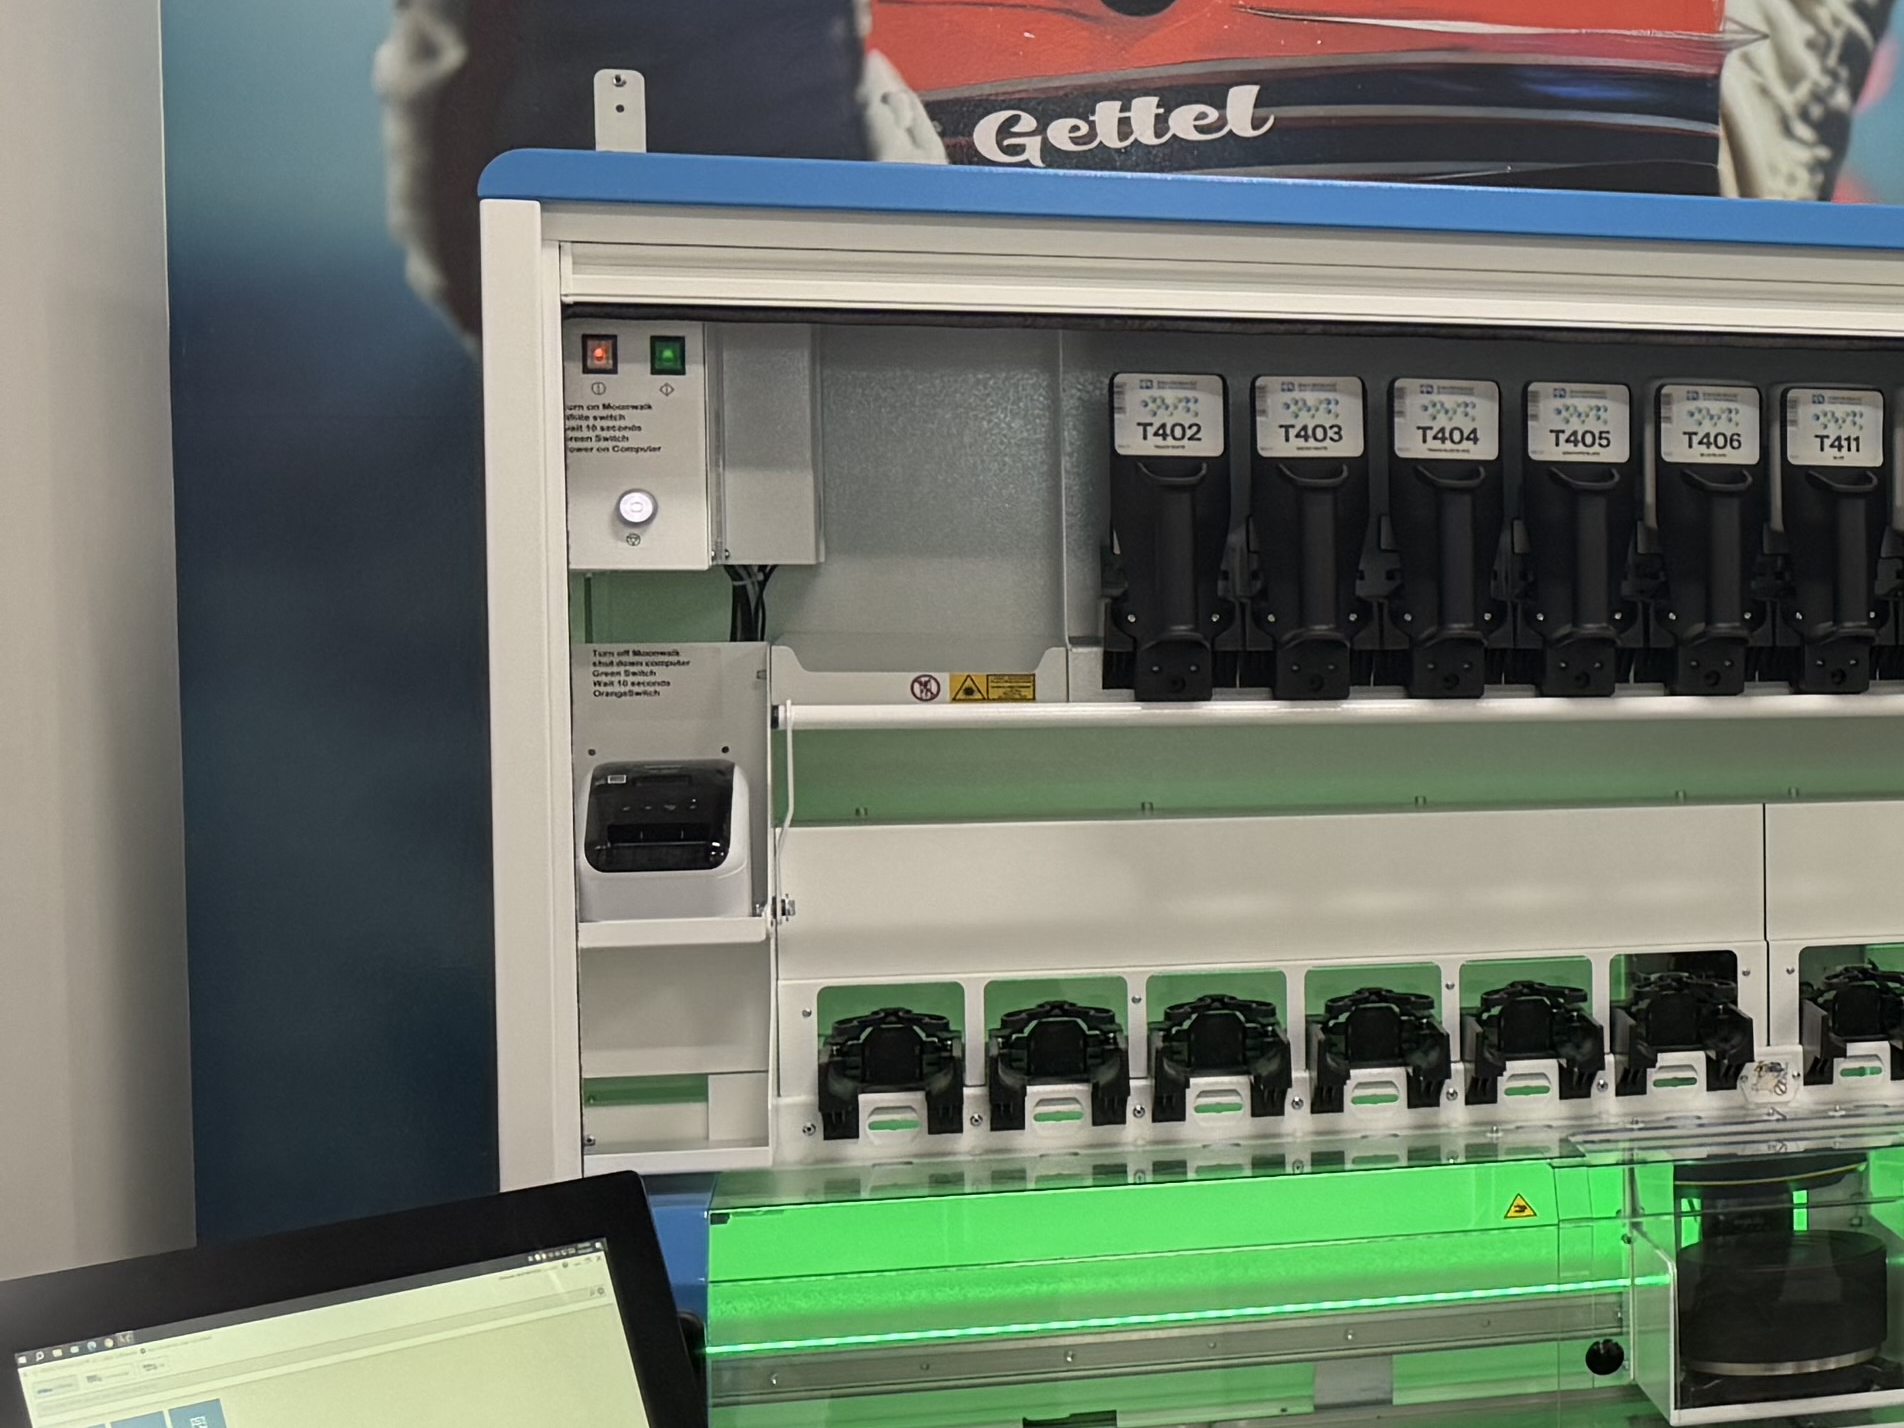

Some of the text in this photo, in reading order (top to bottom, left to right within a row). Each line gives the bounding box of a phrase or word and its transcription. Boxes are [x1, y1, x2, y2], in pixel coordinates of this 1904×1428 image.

[971, 84, 1275, 166] Gettel
[1136, 422, 1202, 442] T402
[1278, 424, 1343, 443] T403
[1416, 426, 1480, 445] T404
[1549, 429, 1611, 448] T405
[1682, 431, 1742, 450] T406
[1814, 434, 1861, 453] T411
